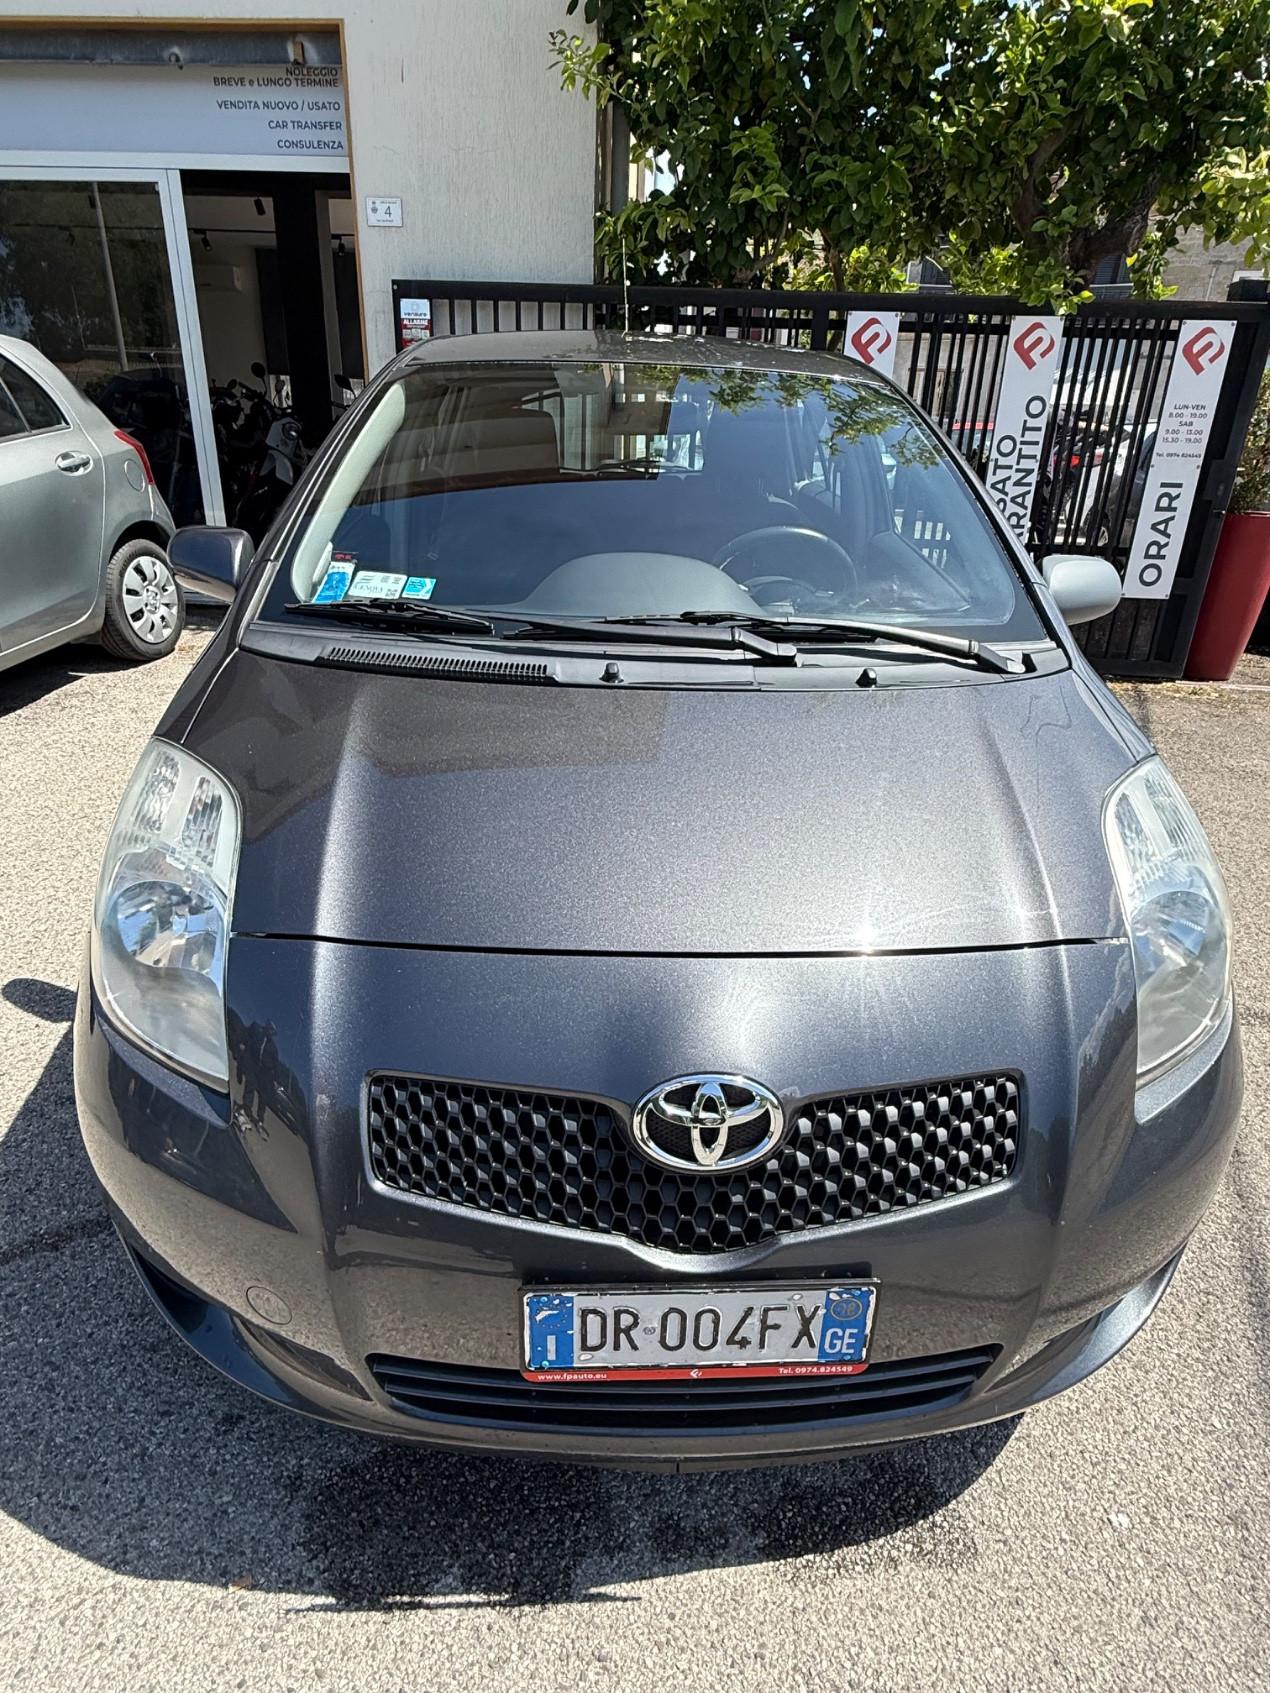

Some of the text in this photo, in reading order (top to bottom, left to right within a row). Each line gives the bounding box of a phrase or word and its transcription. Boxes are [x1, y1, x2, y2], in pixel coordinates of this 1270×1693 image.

[286, 67, 338, 77] NOLEGGIO
[213, 77, 339, 88] BREVE e LUNGO TERMINE
[216, 100, 261, 110] VENDITA
[262, 101, 299, 111] NUOVO
[307, 101, 341, 111] USATO
[268, 120, 342, 131] CAR TRANSFER
[277, 139, 344, 150] CONSULENZA
[384, 205, 393, 218] 4
[1173, 403, 1207, 411] LUN-VEN
[1138, 481, 1184, 588] ORARI
[579, 1305, 641, 1352] DR
[657, 1303, 823, 1352] 004FX
[824, 1328, 856, 1354] GE
[794, 1366, 853, 1374] 0974.824549
[537, 1372, 608, 1381] www.fpauto.eu
